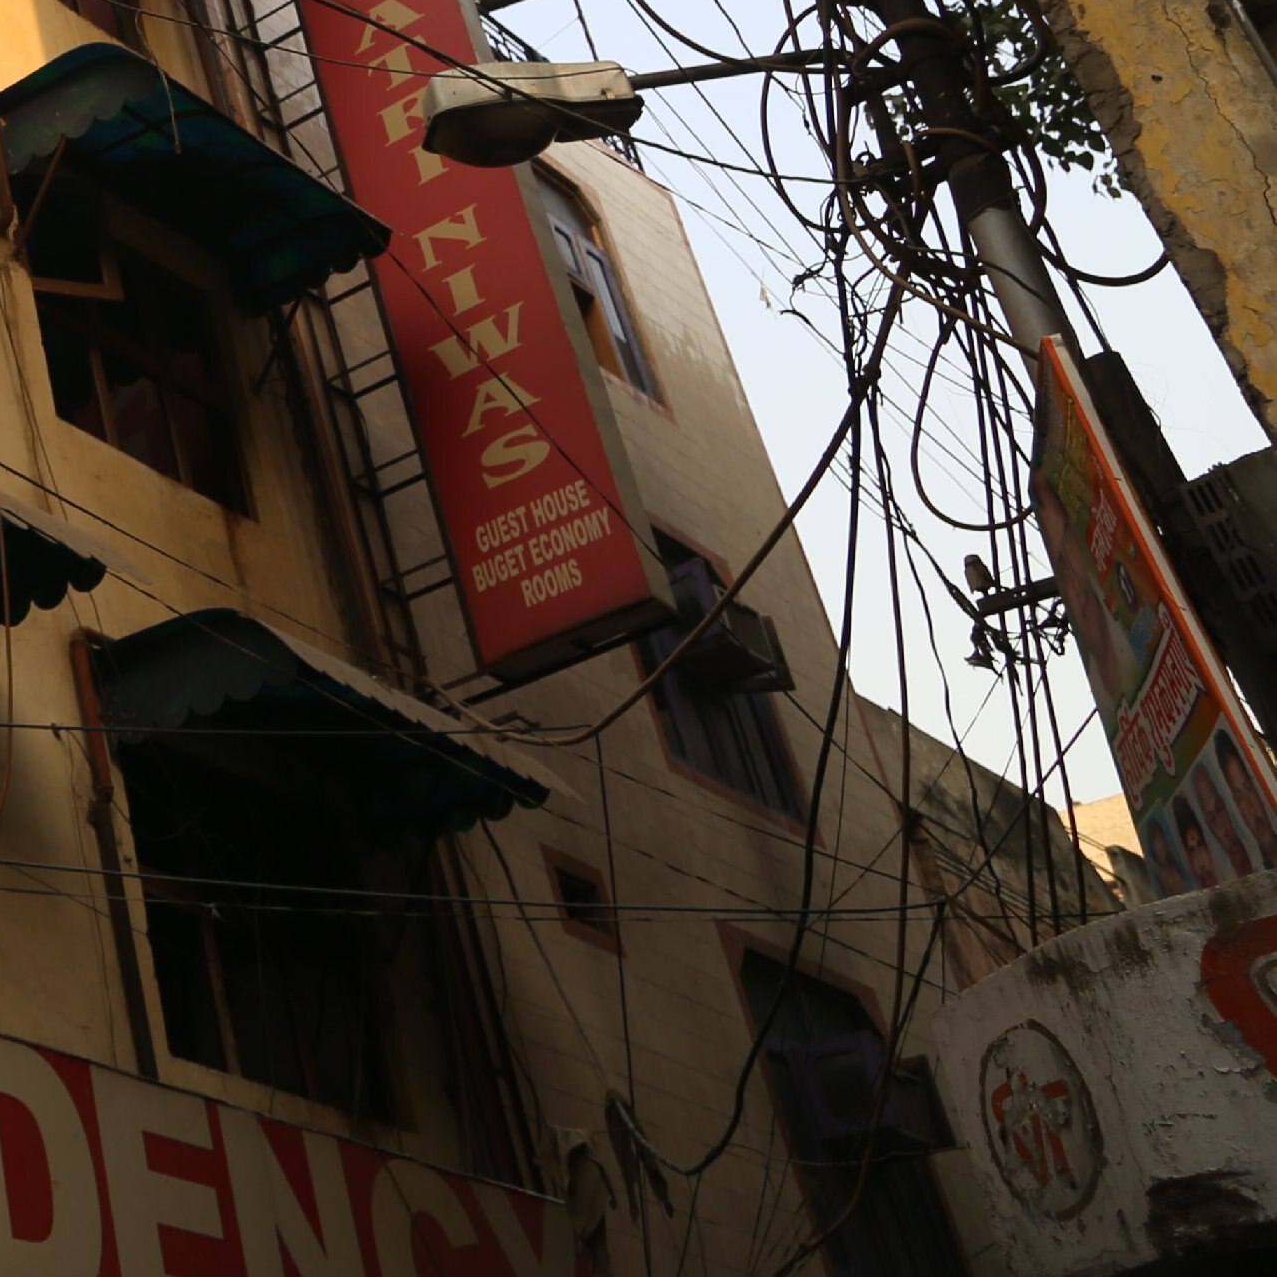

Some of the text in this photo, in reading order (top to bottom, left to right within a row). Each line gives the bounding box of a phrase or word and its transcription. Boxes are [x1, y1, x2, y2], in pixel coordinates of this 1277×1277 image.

[413, 203, 551, 490] NIWAS
[471, 506, 612, 593] BUGET ECONOMY
[475, 479, 591, 553] GUEST HOUSE
[520, 558, 583, 607] ROOMS
